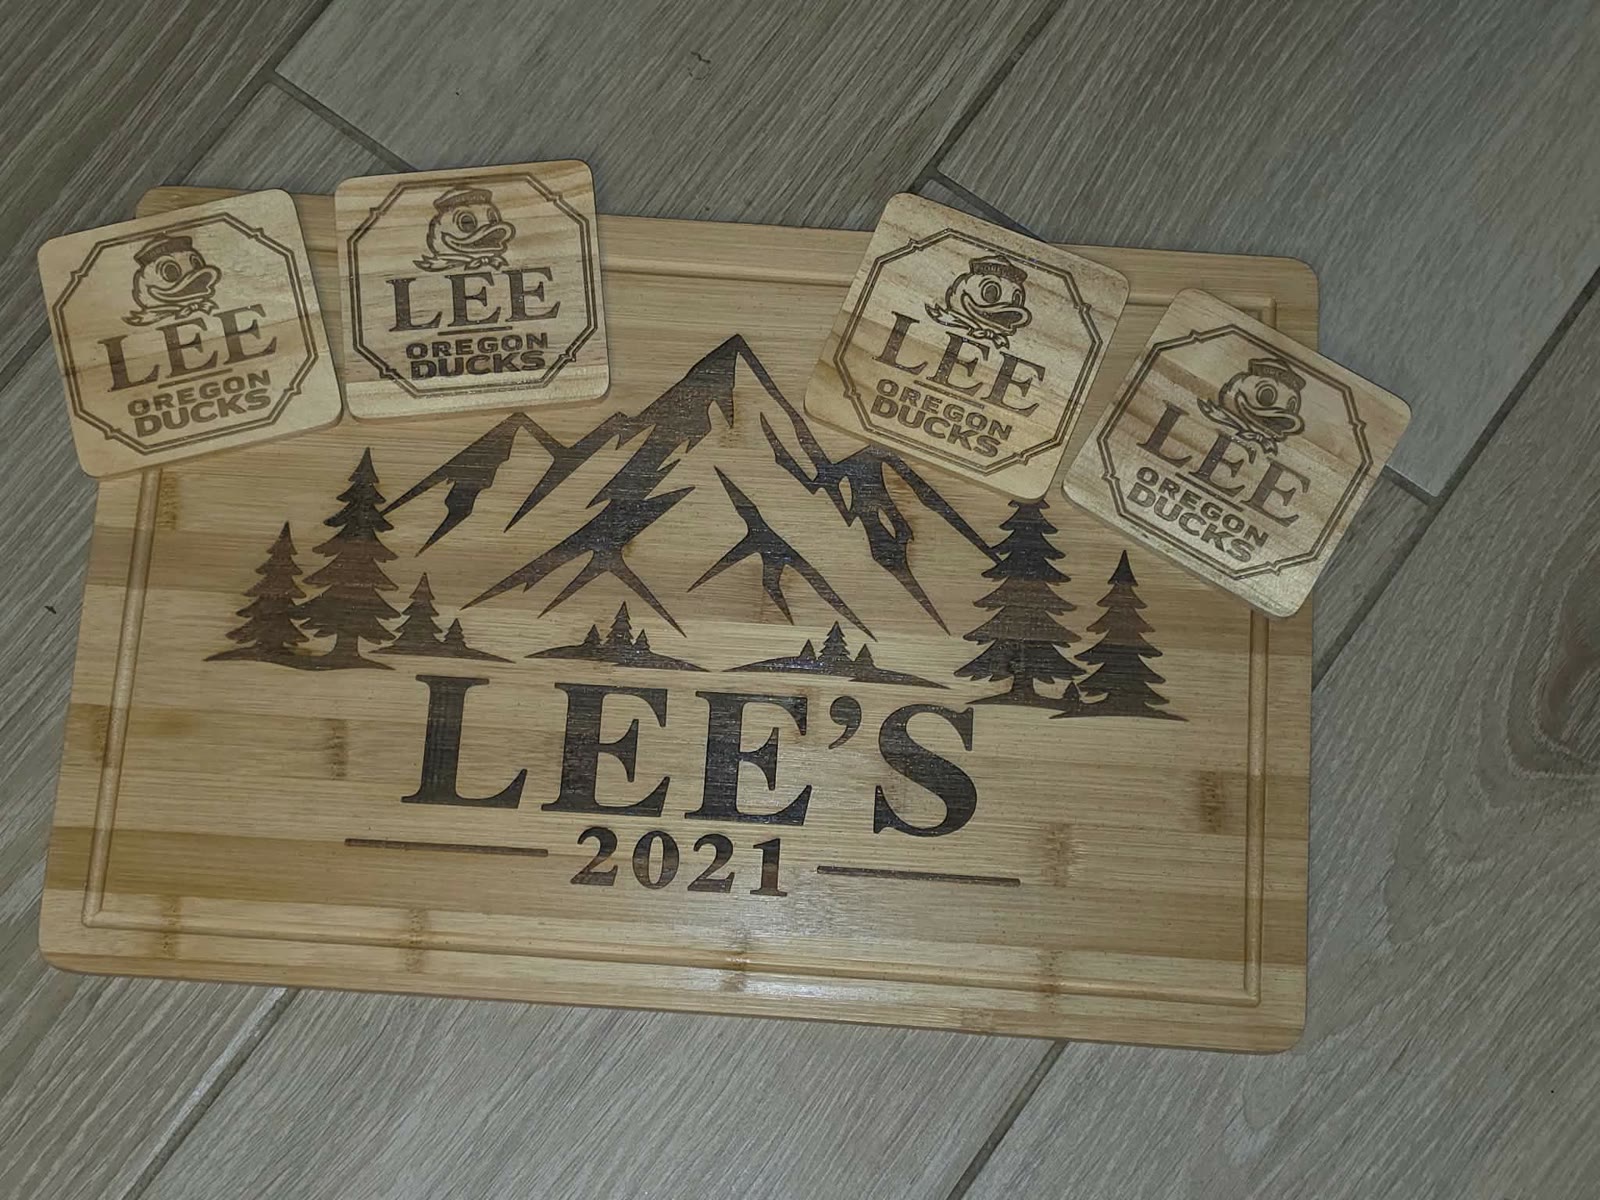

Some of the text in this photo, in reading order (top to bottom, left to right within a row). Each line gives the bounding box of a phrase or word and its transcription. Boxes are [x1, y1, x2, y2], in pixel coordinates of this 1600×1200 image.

[385, 266, 561, 332] LEE
[97, 303, 278, 393] LEE
[405, 332, 549, 359] OREGON
[410, 350, 546, 381] DUCKS
[871, 310, 1046, 418] LEE
[127, 369, 271, 418] OREGON
[133, 388, 272, 438] DUCKS
[870, 395, 1000, 459] DUCKS
[875, 378, 1013, 441] OREGON
[1136, 399, 1311, 528] LEE
[1126, 481, 1252, 563] DUCKS
[1136, 466, 1269, 548] OREGON
[401, 674, 978, 838] LEE'S
[570, 826, 788, 897] 2021
